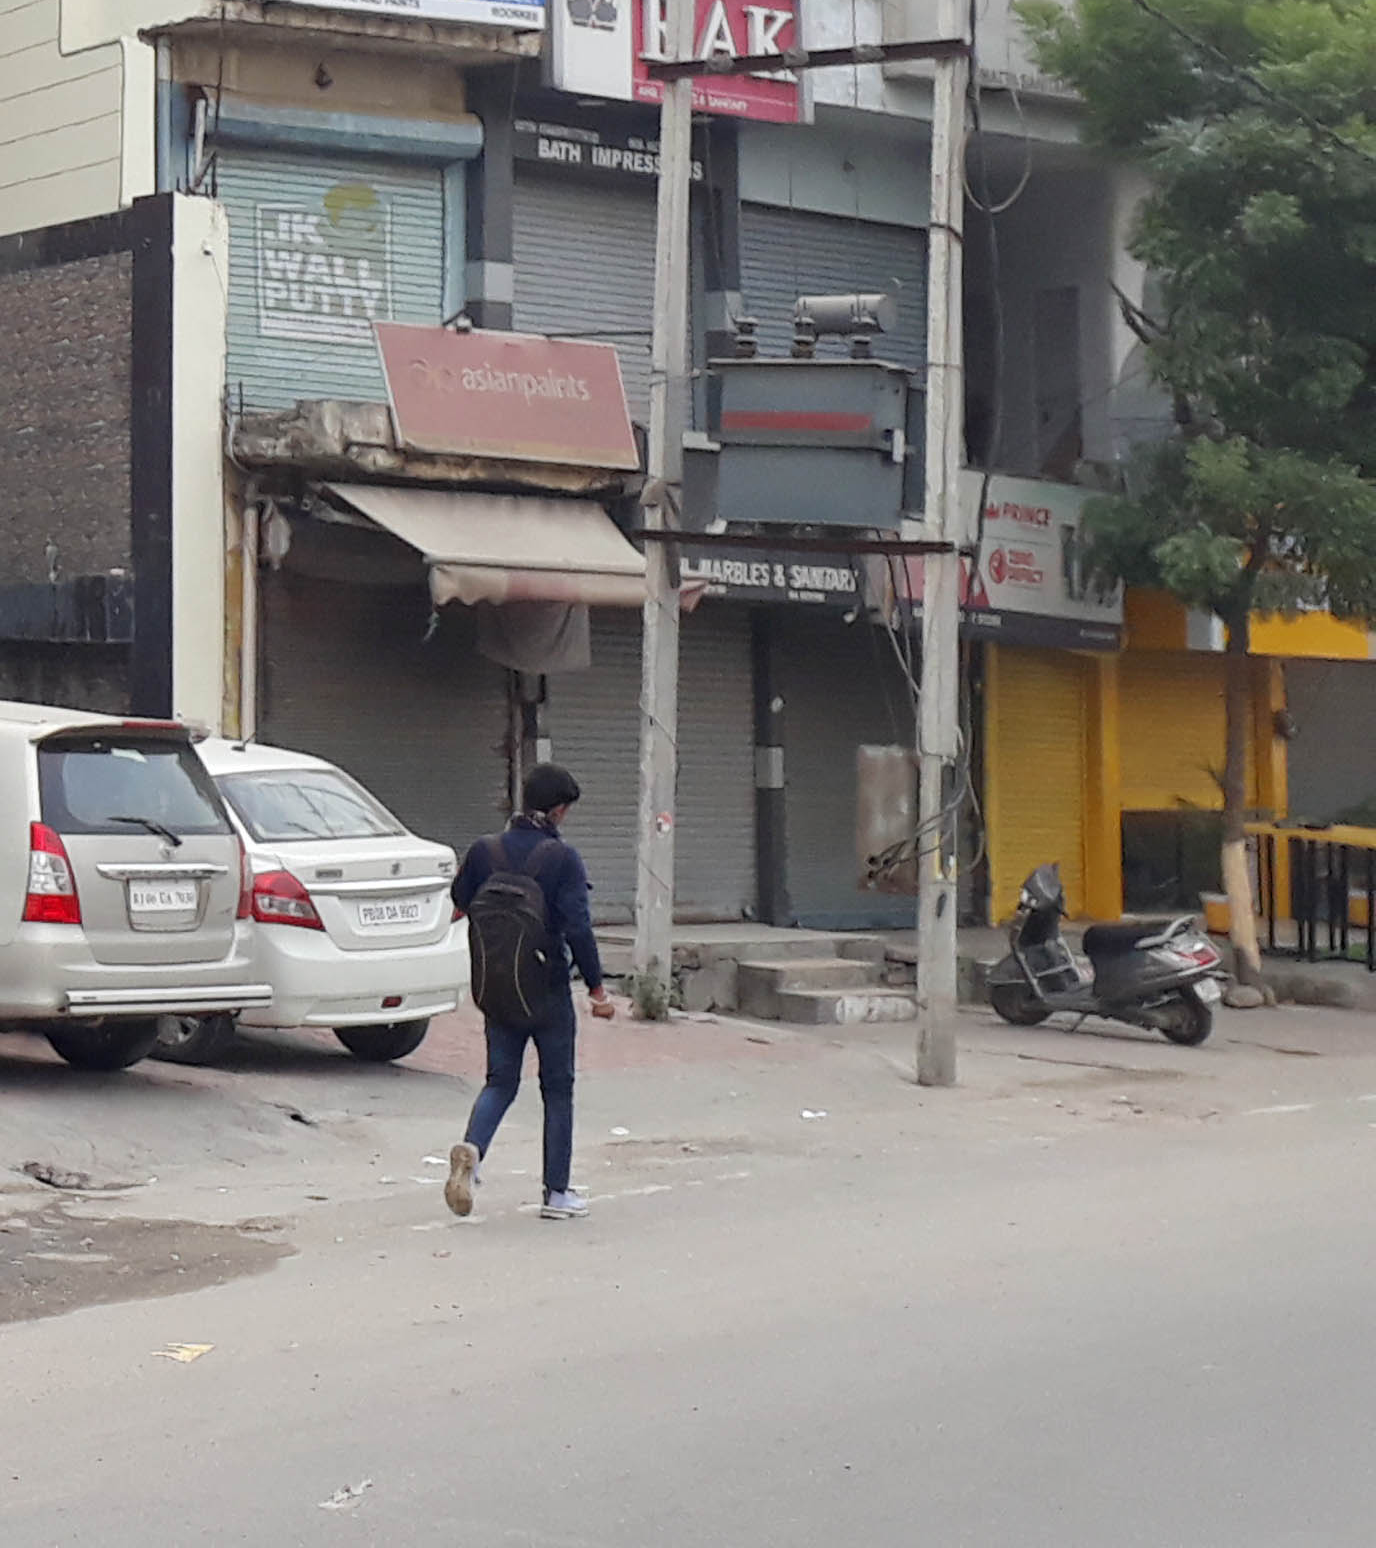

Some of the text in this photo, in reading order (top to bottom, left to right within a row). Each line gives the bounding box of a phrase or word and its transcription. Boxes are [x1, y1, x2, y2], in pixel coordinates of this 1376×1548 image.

[538, 138, 581, 163] BATH
[264, 249, 384, 288] WALL
[264, 282, 382, 317] PUTTY
[700, 558, 770, 587] MARBLES
[773, 563, 786, 587] &
